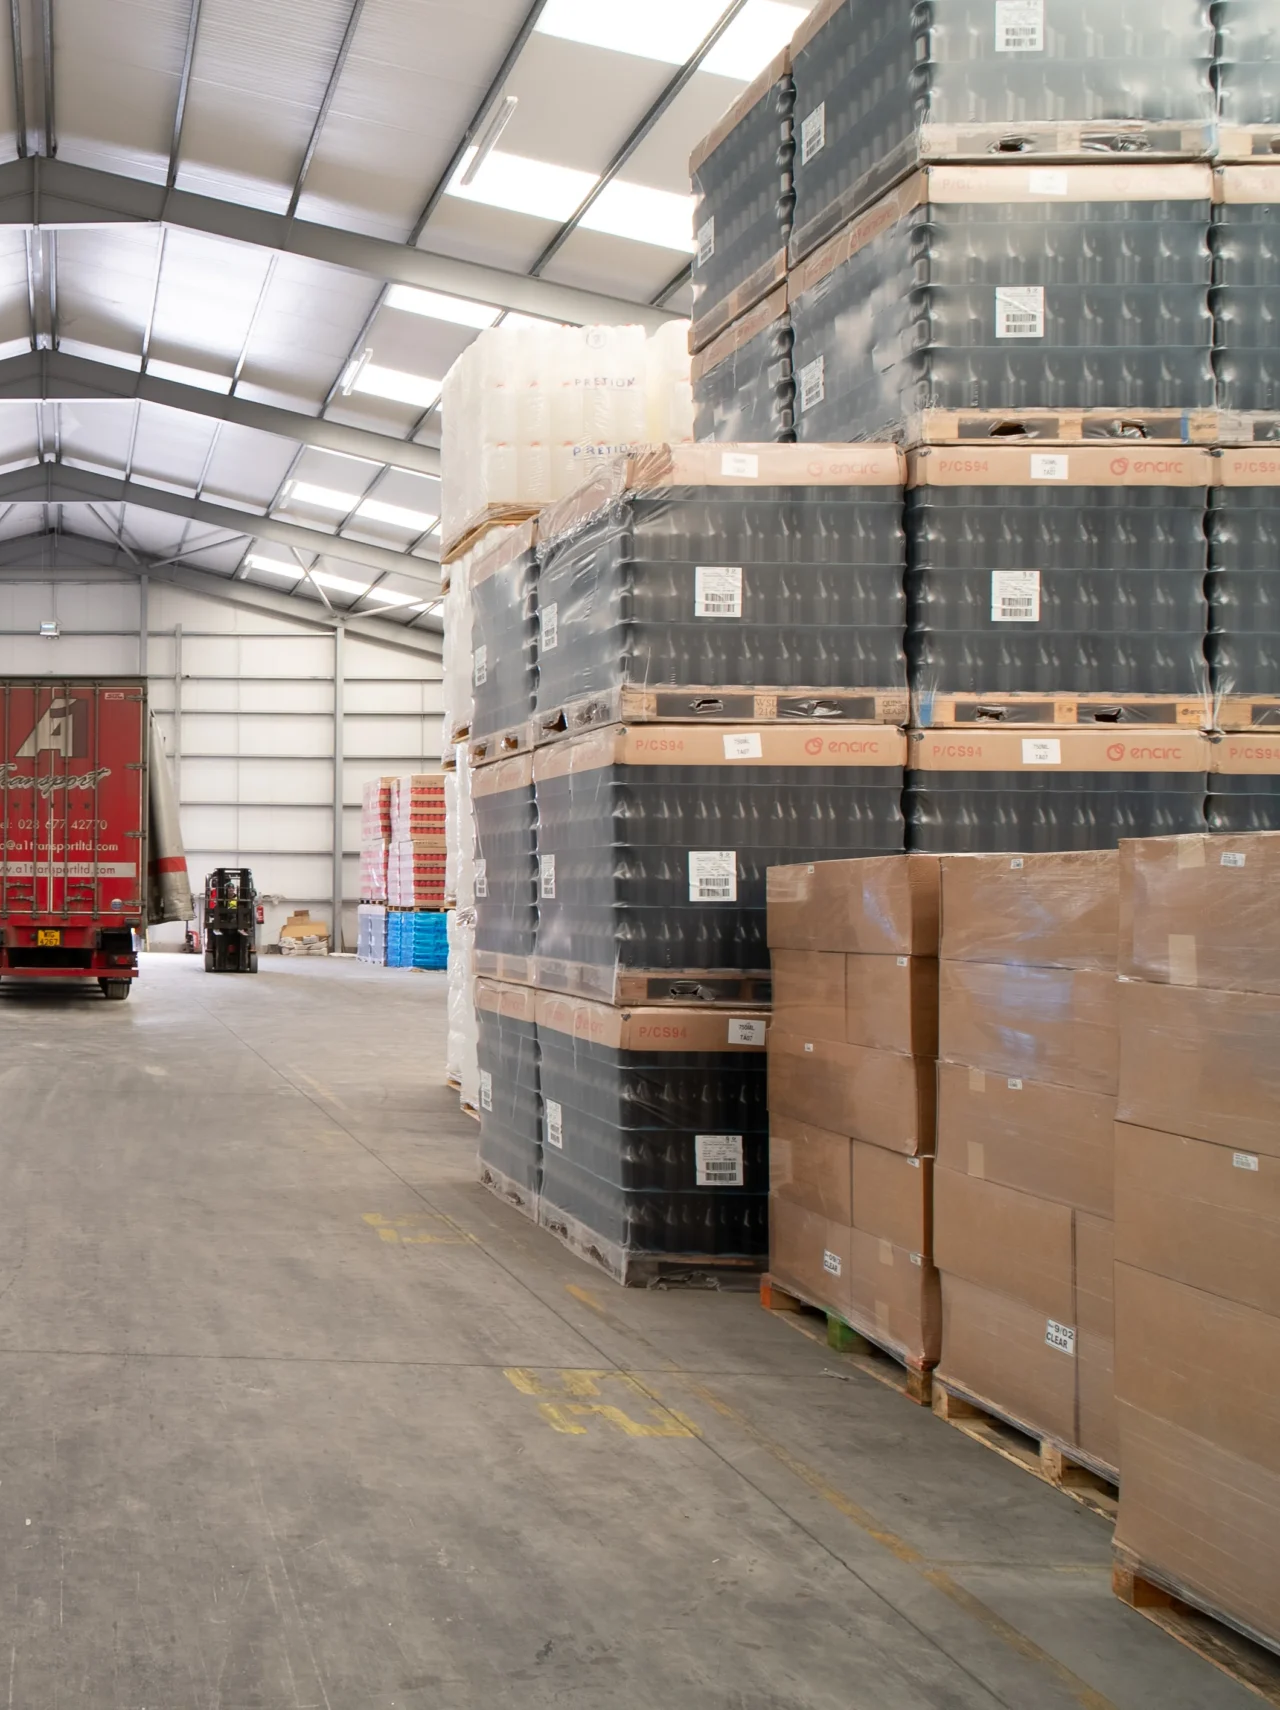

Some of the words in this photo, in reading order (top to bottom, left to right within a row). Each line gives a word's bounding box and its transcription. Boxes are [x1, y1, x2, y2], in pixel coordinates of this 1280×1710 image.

[829, 460, 880, 475] encirc
[939, 460, 989, 472] P/CS94
[1134, 461, 1184, 474] encirc
[635, 739, 685, 752] P/CS94
[827, 740, 879, 753] encirc
[932, 746, 983, 758] P/CS94
[1130, 746, 1182, 760] encirc
[638, 1026, 687, 1038] P/CS94
[824, 1259, 838, 1273] CLEAR
[1046, 1331, 1068, 1350] CLEAR
